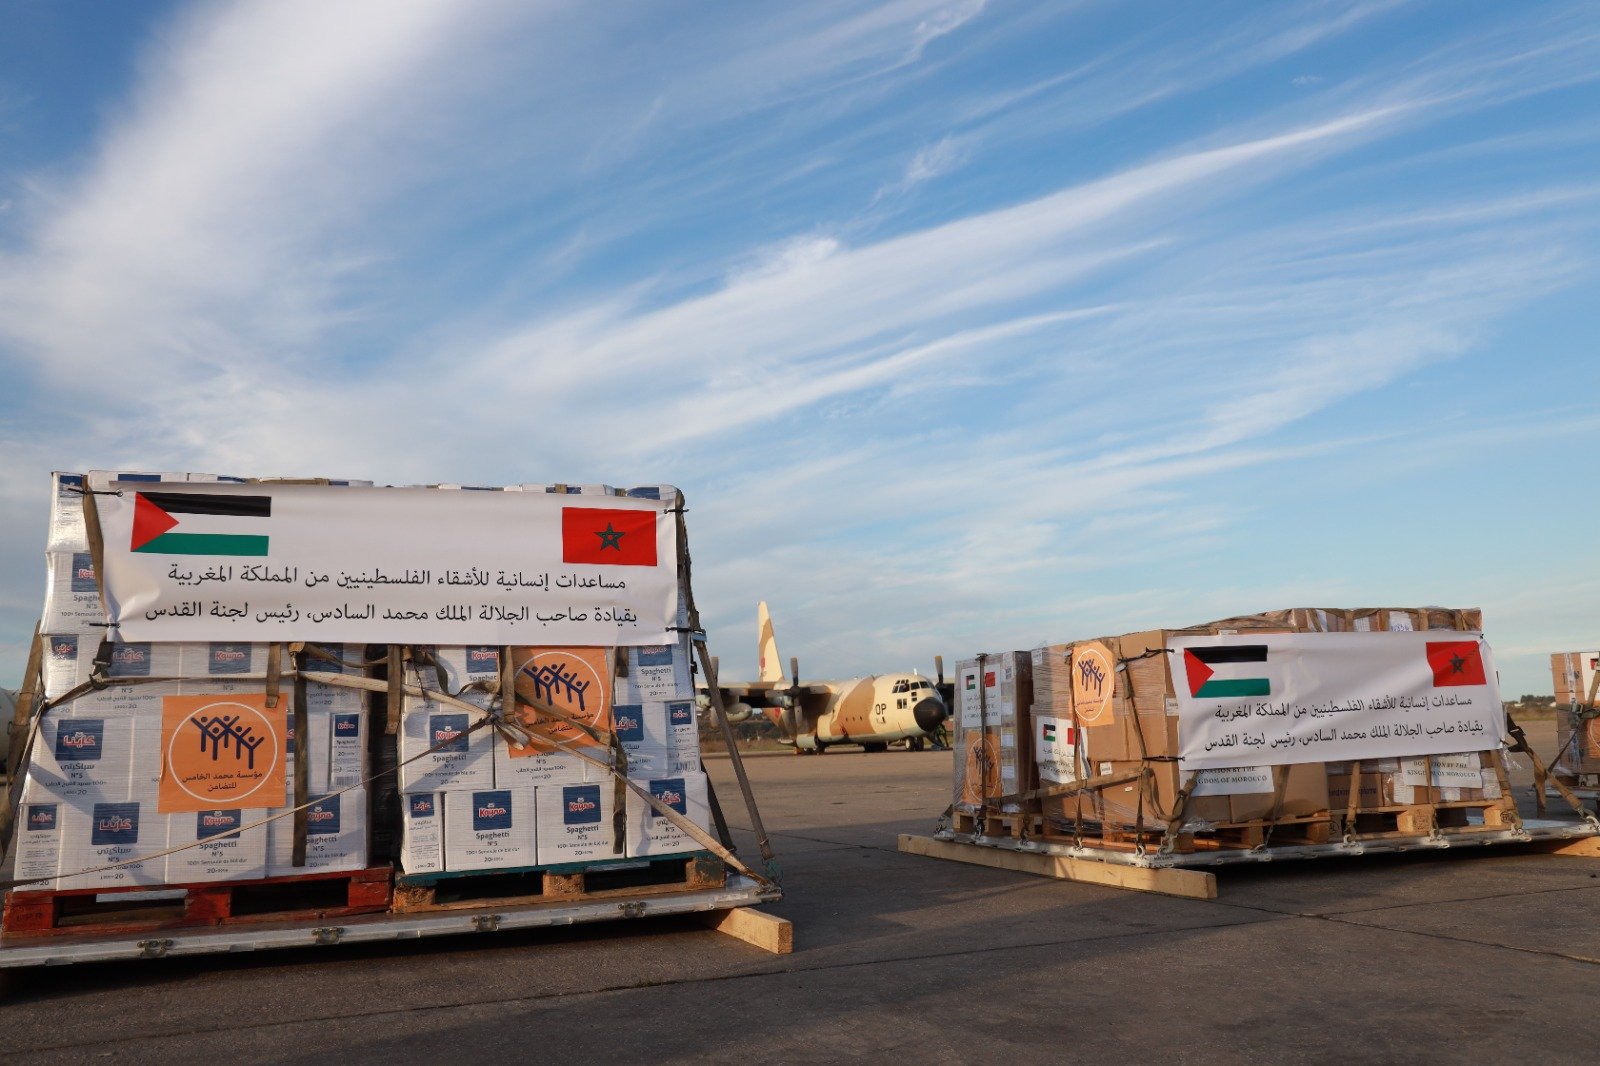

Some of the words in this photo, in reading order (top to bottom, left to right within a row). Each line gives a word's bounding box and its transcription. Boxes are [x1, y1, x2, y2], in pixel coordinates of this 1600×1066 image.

[168, 563, 232, 586] المغربية
[240, 565, 297, 584] المملكة
[305, 572, 330, 587] من
[336, 567, 430, 589] الفلسطينيين
[437, 567, 490, 586] للأشقاء
[496, 571, 549, 591] إنسانية
[556, 573, 626, 589] مساعدات
[145, 601, 201, 621] القدس
[209, 601, 248, 622] لجنة
[256, 604, 300, 623] رئيس
[306, 604, 375, 623] السادس،
[382, 608, 429, 621] محمد
[435, 604, 472, 621] الملك
[478, 604, 529, 626] الجلالة
[536, 607, 587, 626] صاحب
[594, 605, 637, 627] بقيادة
[1368, 694, 1396, 711] للأشقاء
[1400, 696, 1429, 712] إنسانية
[1432, 694, 1472, 707] مساعدات
[875, 703, 887, 715] OP
[1215, 704, 1251, 722] المغربية
[1256, 702, 1289, 717] المملكة
[1294, 706, 1307, 719] من
[1310, 699, 1364, 719] الفلسطينيين
[1340, 729, 1367, 741] محمد
[1370, 724, 1390, 739] الملك
[1394, 723, 1422, 740] الجلالة
[1425, 722, 1454, 739] صاحب
[1458, 720, 1484, 736] بقيادة
[1205, 734, 1238, 751] القدس
[1243, 732, 1265, 749] لجنة
[1270, 732, 1296, 748] رئيس
[1299, 728, 1337, 746] السادس،
[432, 754, 467, 763] Spaghetti
[182, 772, 210, 783] الخامس
[236, 771, 263, 780] مؤسسة
[1231, 775, 1268, 783] MOROCCO
[208, 782, 237, 792] للتضامن
[478, 807, 507, 818] Kayna
[475, 831, 510, 841] Spaghetti
[566, 824, 599, 835] Spaghetti
[199, 841, 237, 851] Spaghetti
